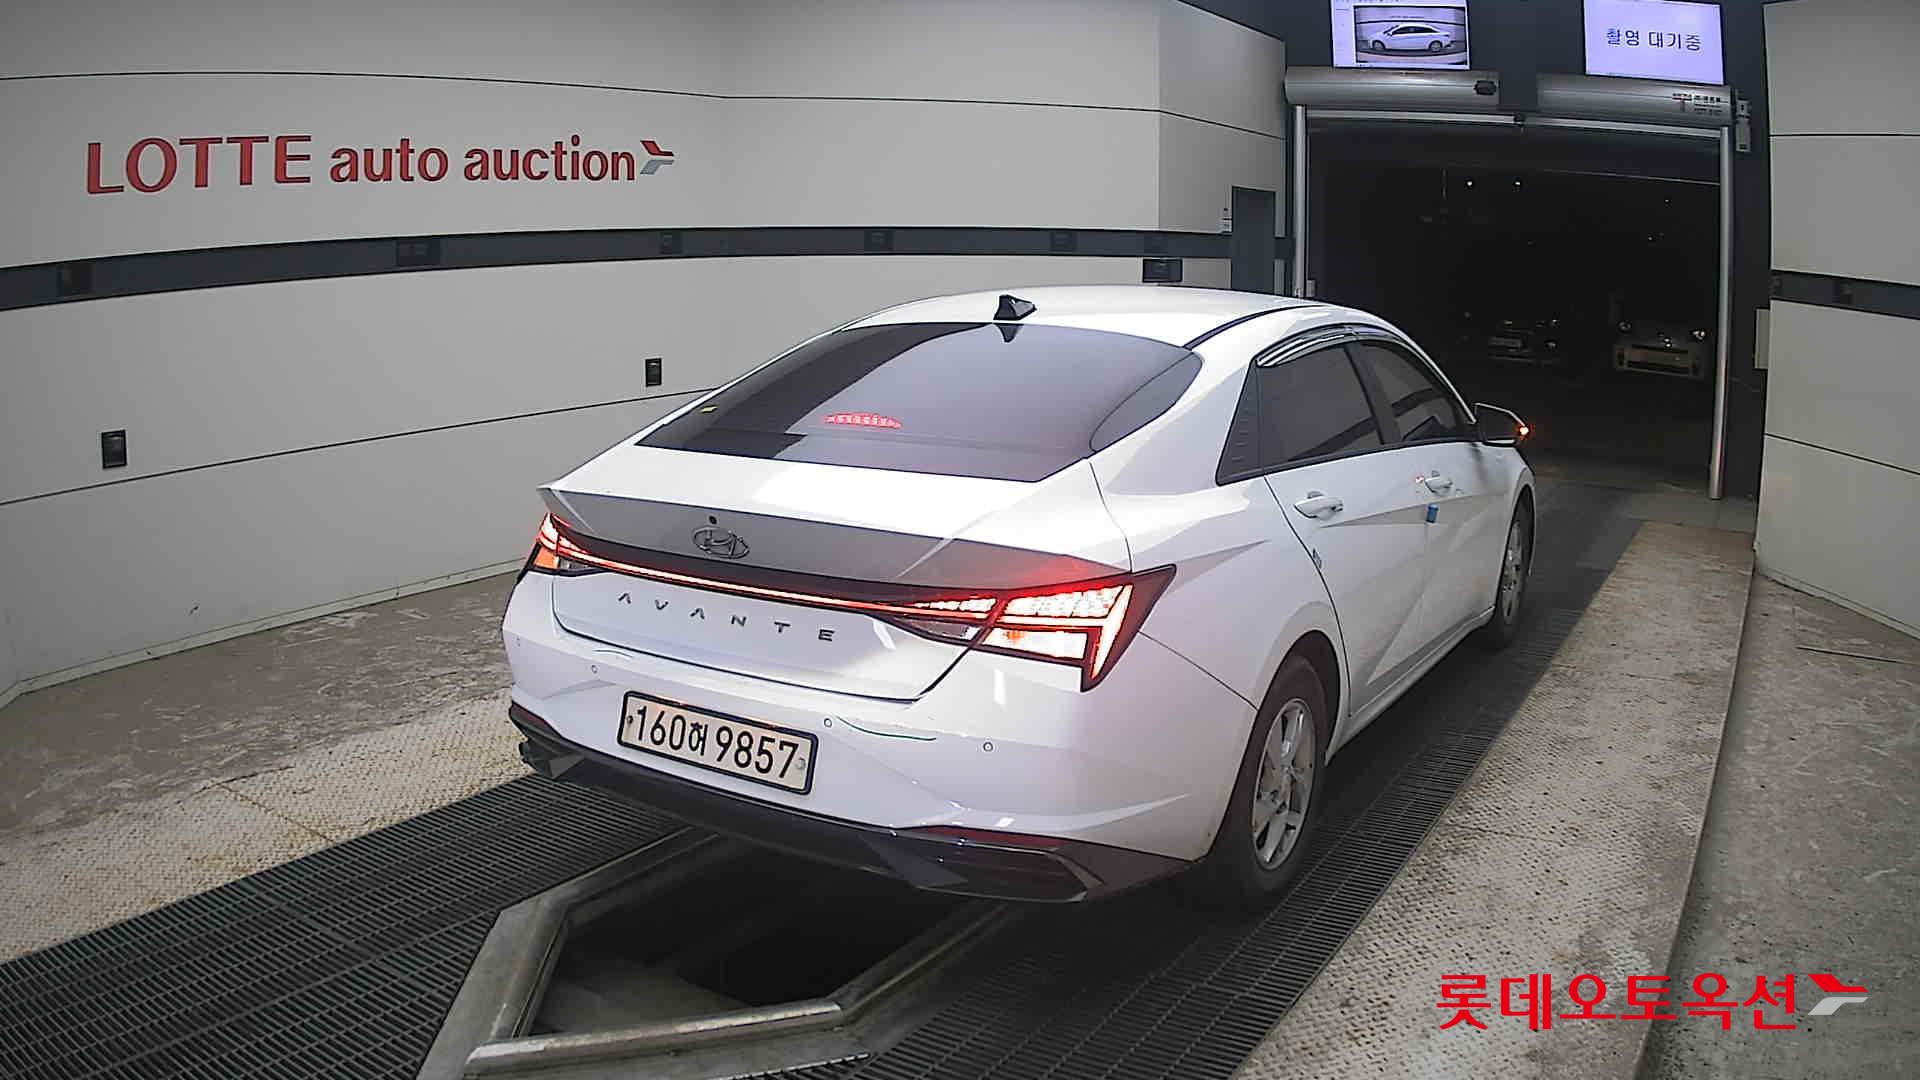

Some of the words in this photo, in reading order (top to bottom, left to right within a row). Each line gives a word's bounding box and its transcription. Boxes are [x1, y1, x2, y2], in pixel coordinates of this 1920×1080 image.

[1648, 31, 1701, 51] 대기중
[87, 135, 312, 195] LOTTE
[329, 137, 450, 183] auto
[463, 134, 637, 182] auction
[617, 592, 835, 642] AVANTE
[715, 725, 800, 779] 9857
